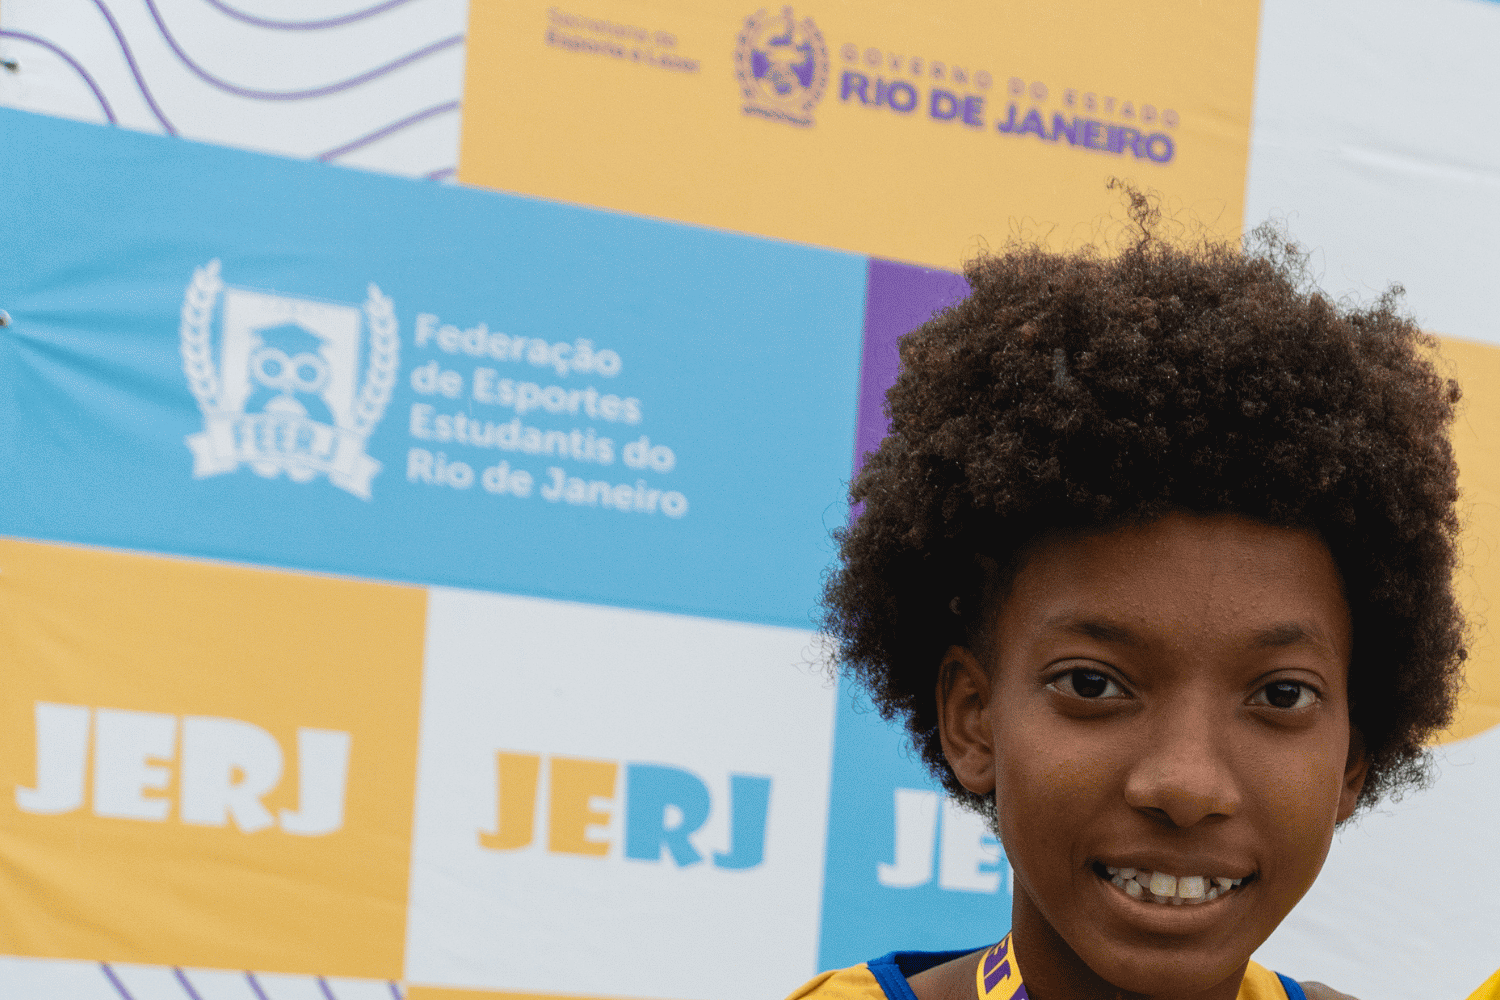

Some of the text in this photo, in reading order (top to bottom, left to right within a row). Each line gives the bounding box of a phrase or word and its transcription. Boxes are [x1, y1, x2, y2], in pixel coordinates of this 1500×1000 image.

[839, 69, 920, 115] RIO
[930, 86, 987, 132] DE
[995, 99, 1178, 165] JANEIRO
[840, 42, 1180, 130] GOVERNO DO ESTADO
[415, 312, 623, 378] Federação
[410, 360, 642, 425] de Esportes
[409, 402, 676, 474] Estudantis do
[406, 447, 689, 519] Rio de Janeiro
[15, 700, 353, 838] JERJ
[477, 749, 774, 871] JERJ
[877, 787, 1013, 894] JE
